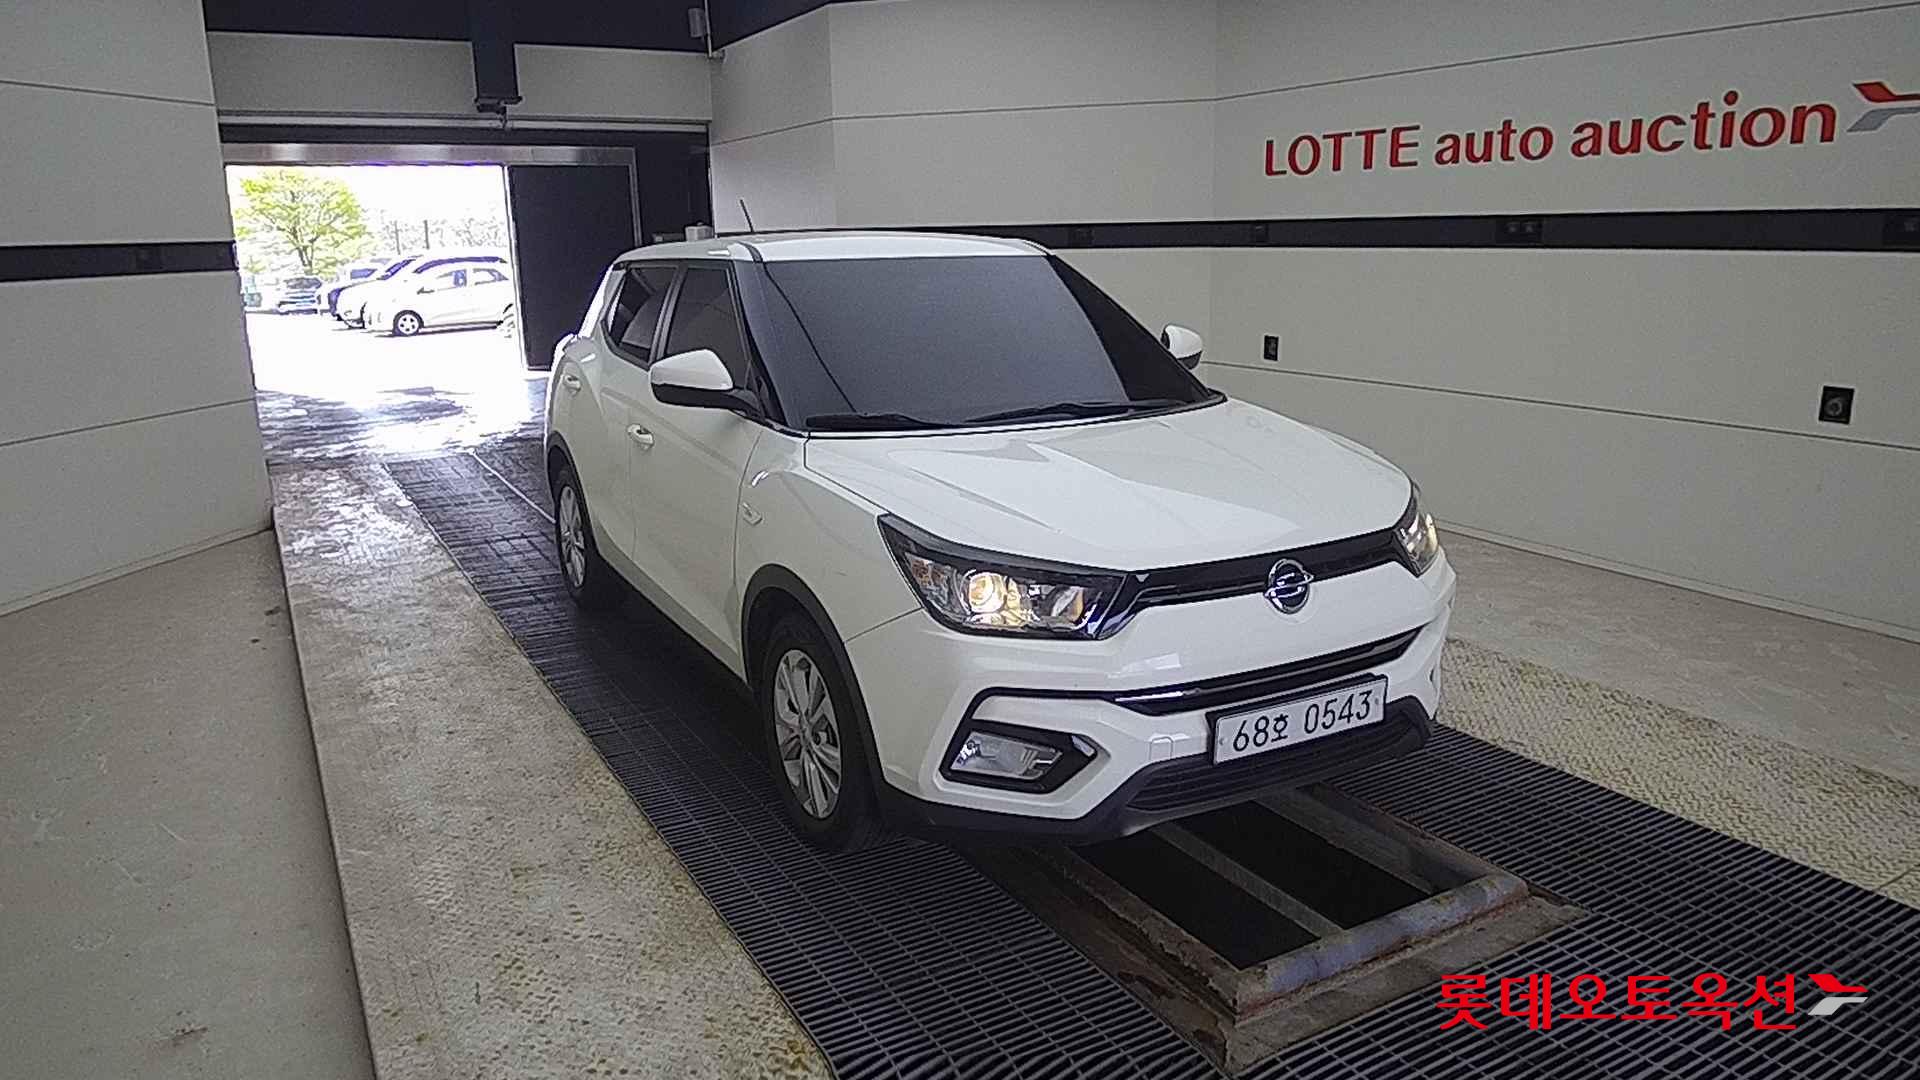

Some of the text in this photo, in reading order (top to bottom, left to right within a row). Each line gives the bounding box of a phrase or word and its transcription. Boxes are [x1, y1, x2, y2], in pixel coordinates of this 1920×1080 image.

[1265, 90, 1837, 177] LOTTE auto auction
[1232, 689, 1373, 752] 68호 0543
